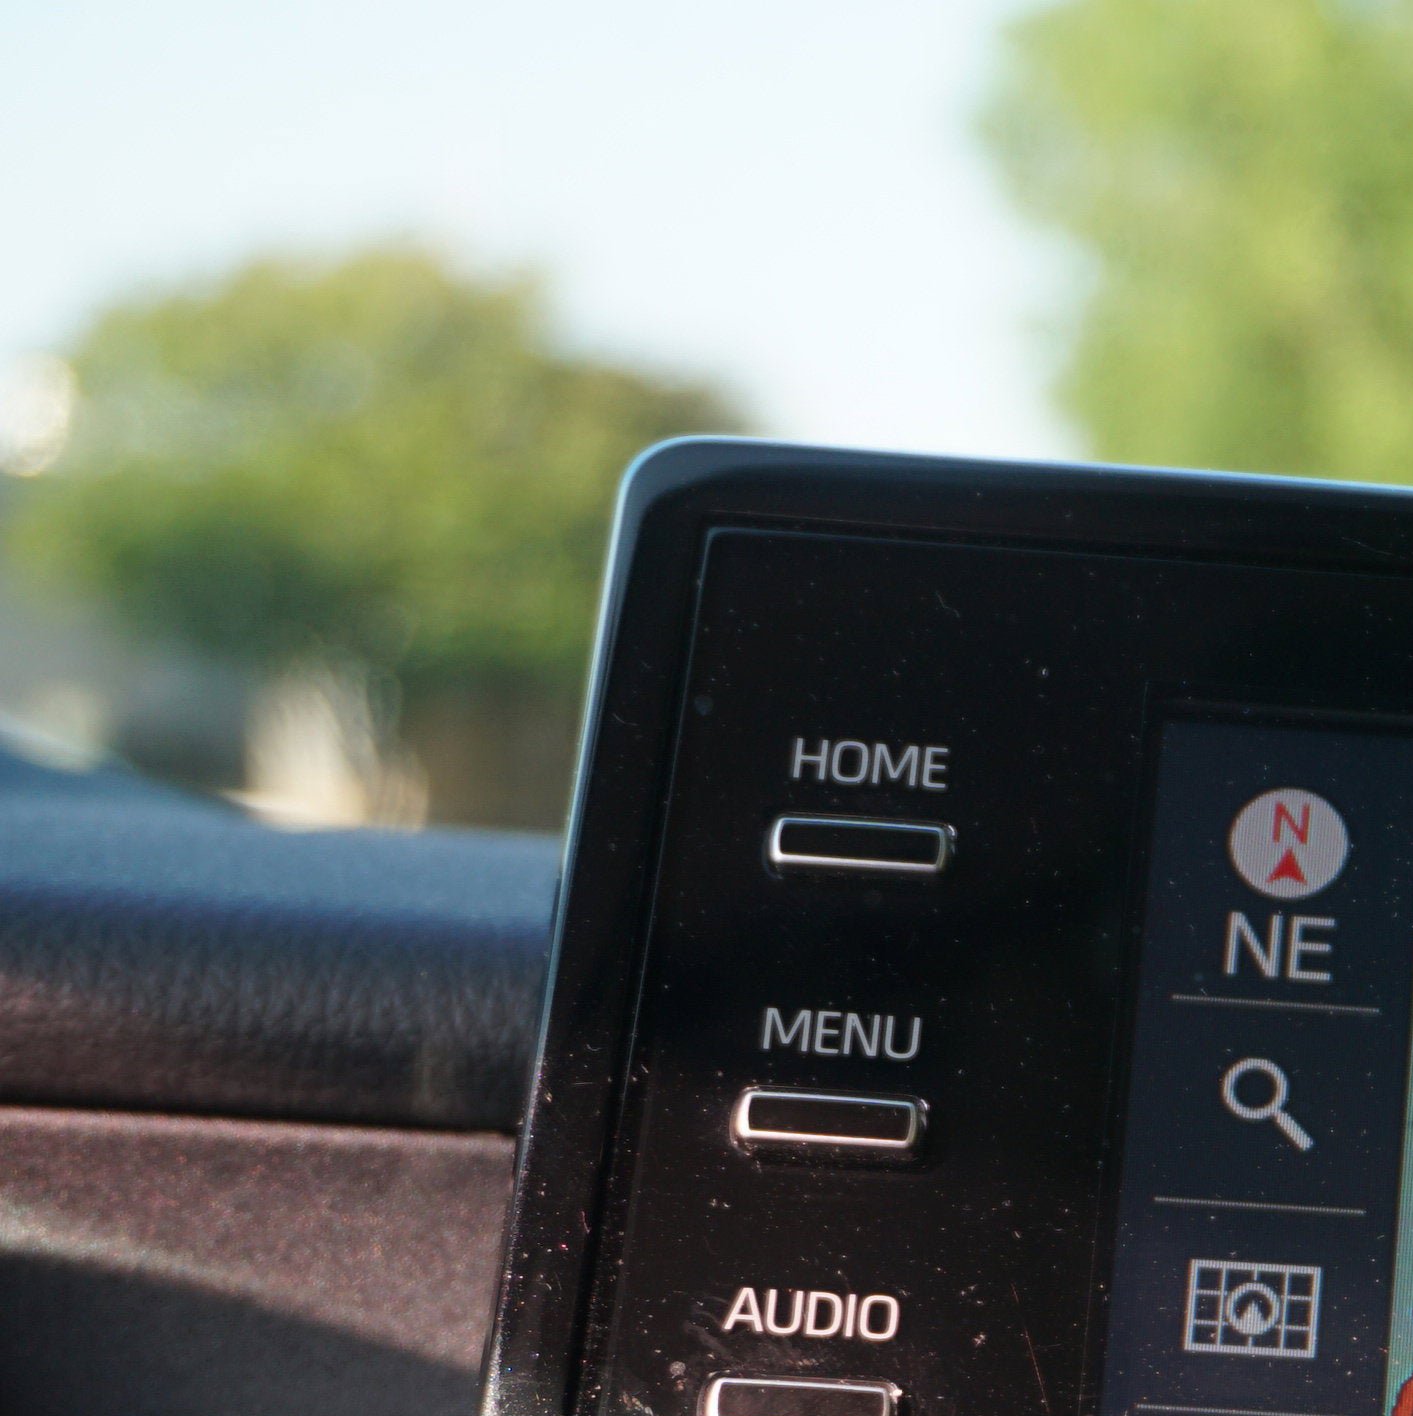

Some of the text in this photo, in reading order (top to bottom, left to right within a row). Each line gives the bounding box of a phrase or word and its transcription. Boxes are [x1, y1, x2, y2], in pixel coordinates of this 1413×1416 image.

[790, 738, 950, 791] HOME
[1271, 803, 1312, 845] N
[1223, 911, 1336, 982] NE
[761, 1007, 921, 1061] MENU
[724, 1288, 900, 1342] AUDIO
